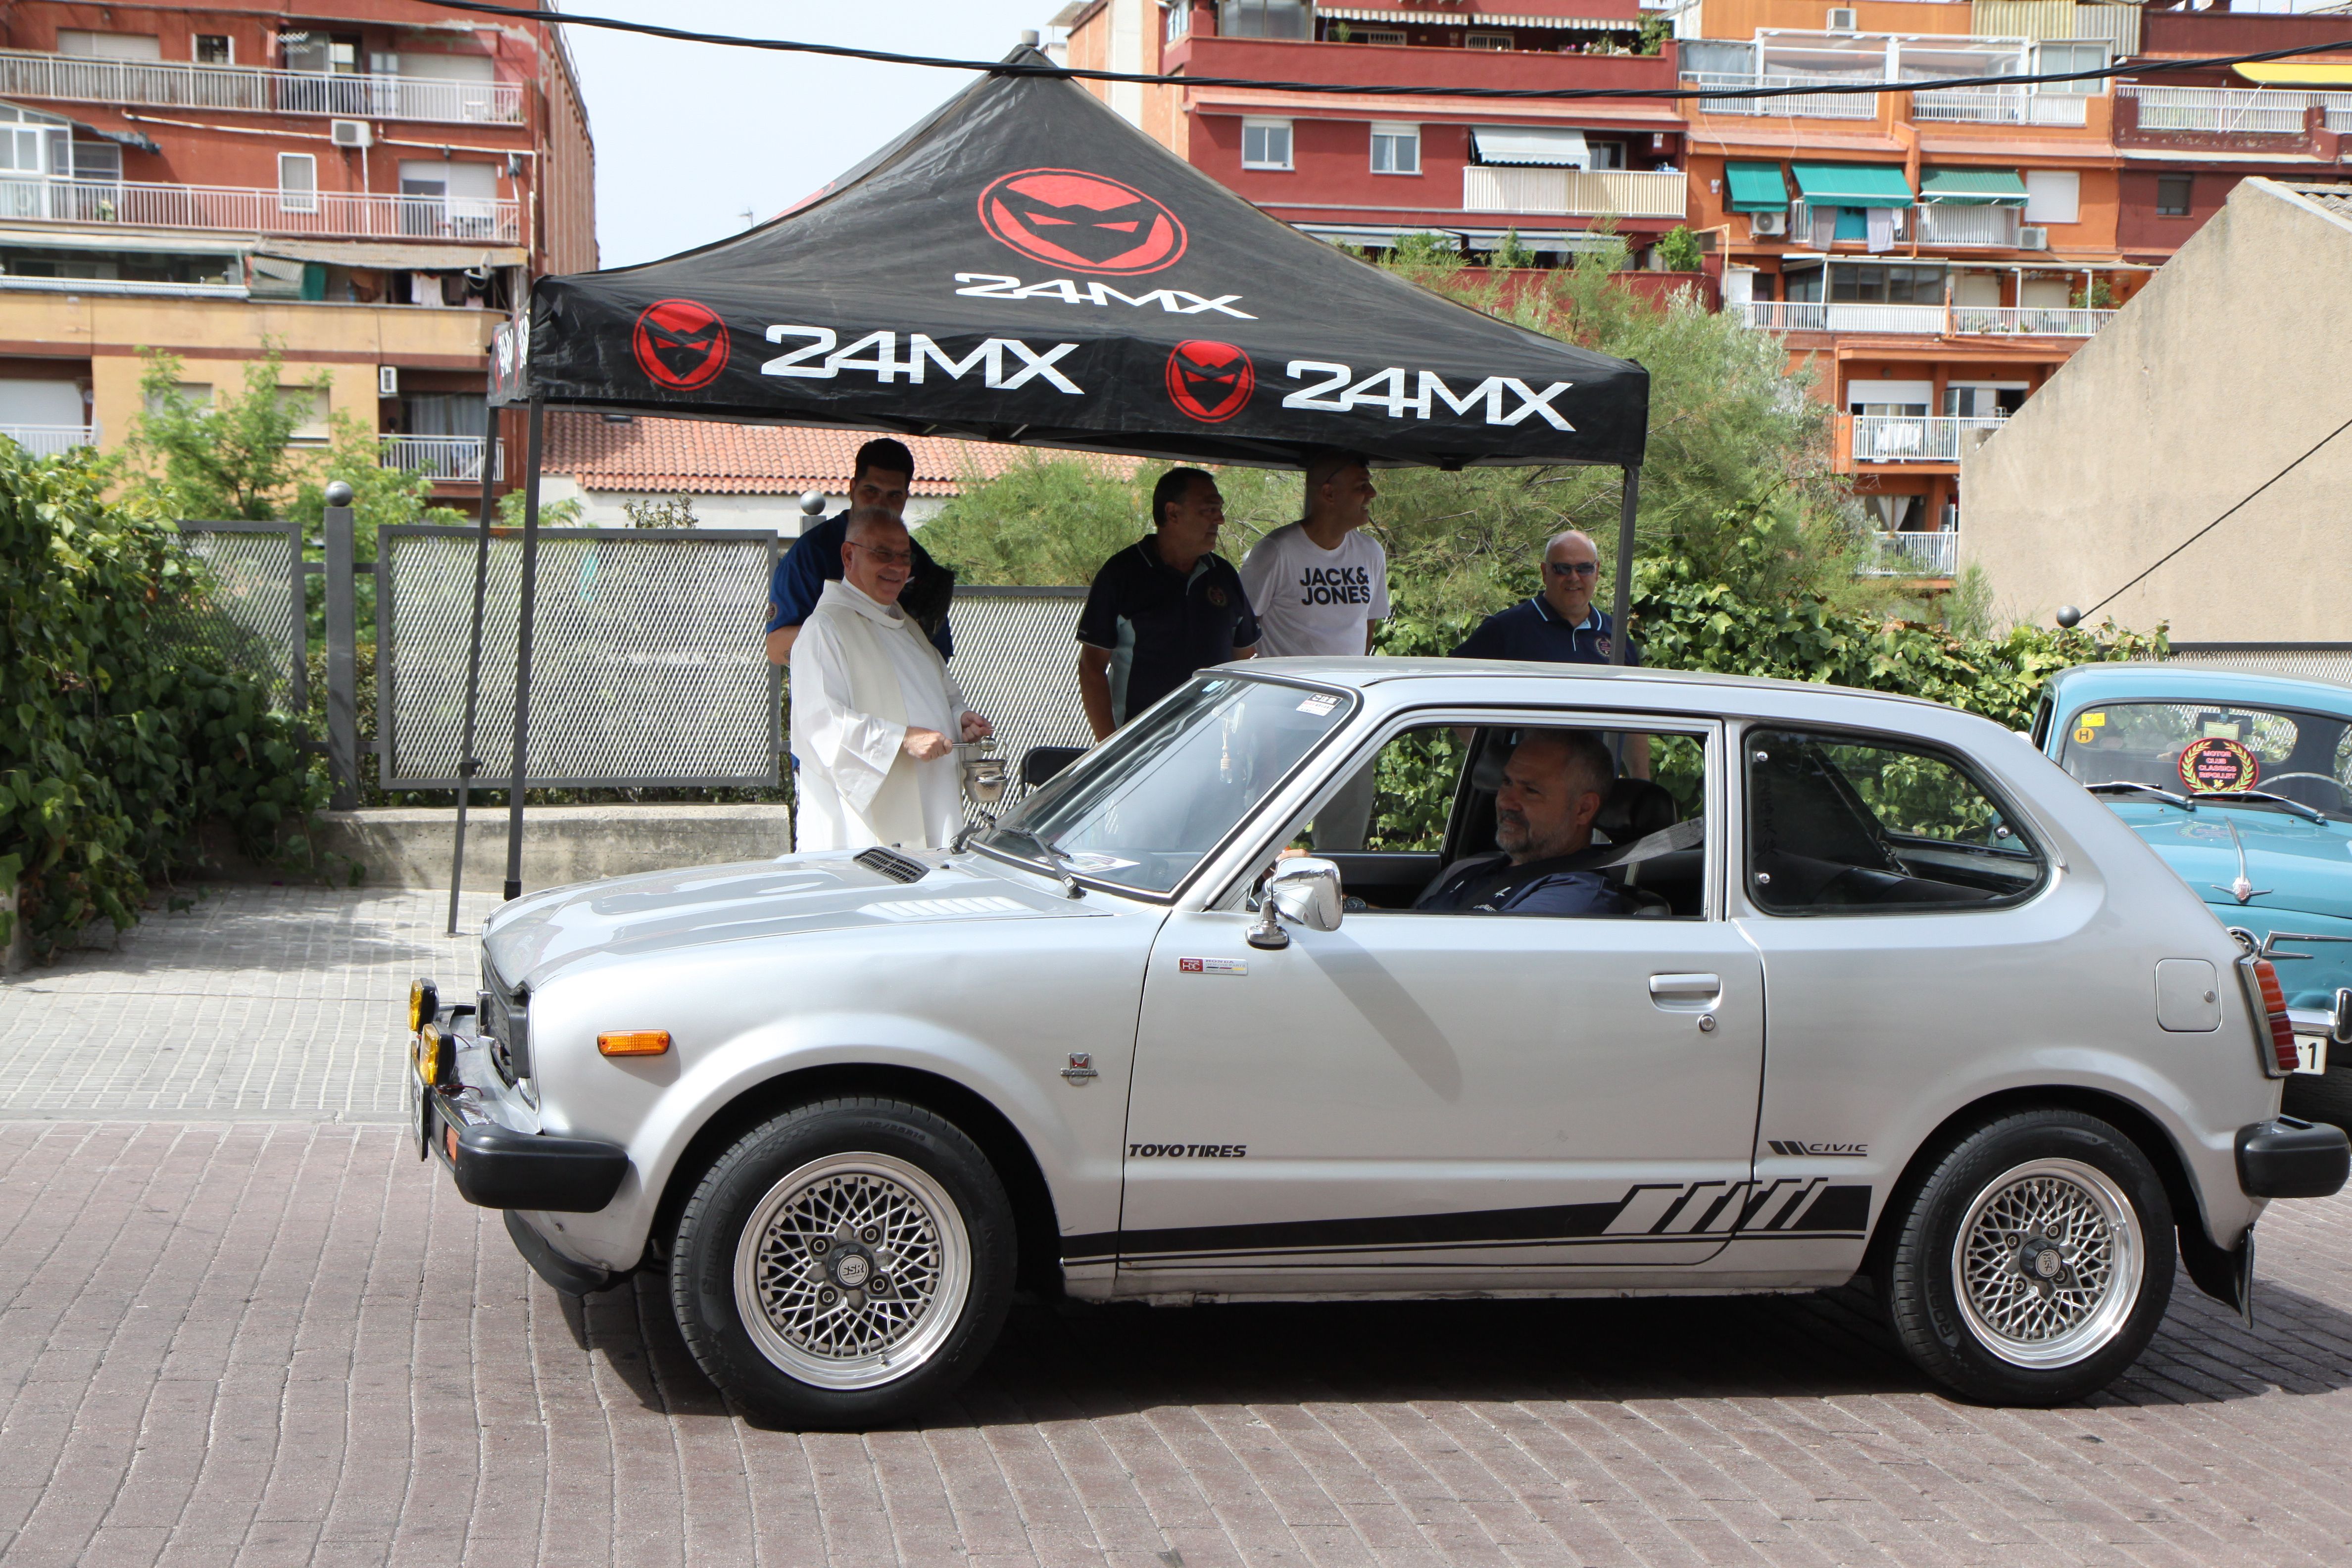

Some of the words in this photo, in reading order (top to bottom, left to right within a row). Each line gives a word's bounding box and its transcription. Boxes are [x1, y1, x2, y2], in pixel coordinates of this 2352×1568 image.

[955, 273, 1259, 320] 24MX
[761, 325, 1085, 394] 24MX
[1282, 360, 1576, 432] 24MX
[1301, 585, 1371, 605] JONES
[2079, 730, 2089, 740] H
[1129, 1144, 1185, 1157] TOYO
[1187, 1144, 1247, 1157] TIRES
[1810, 1143, 1868, 1152] CIVIC
[842, 1263, 864, 1276] SSR
